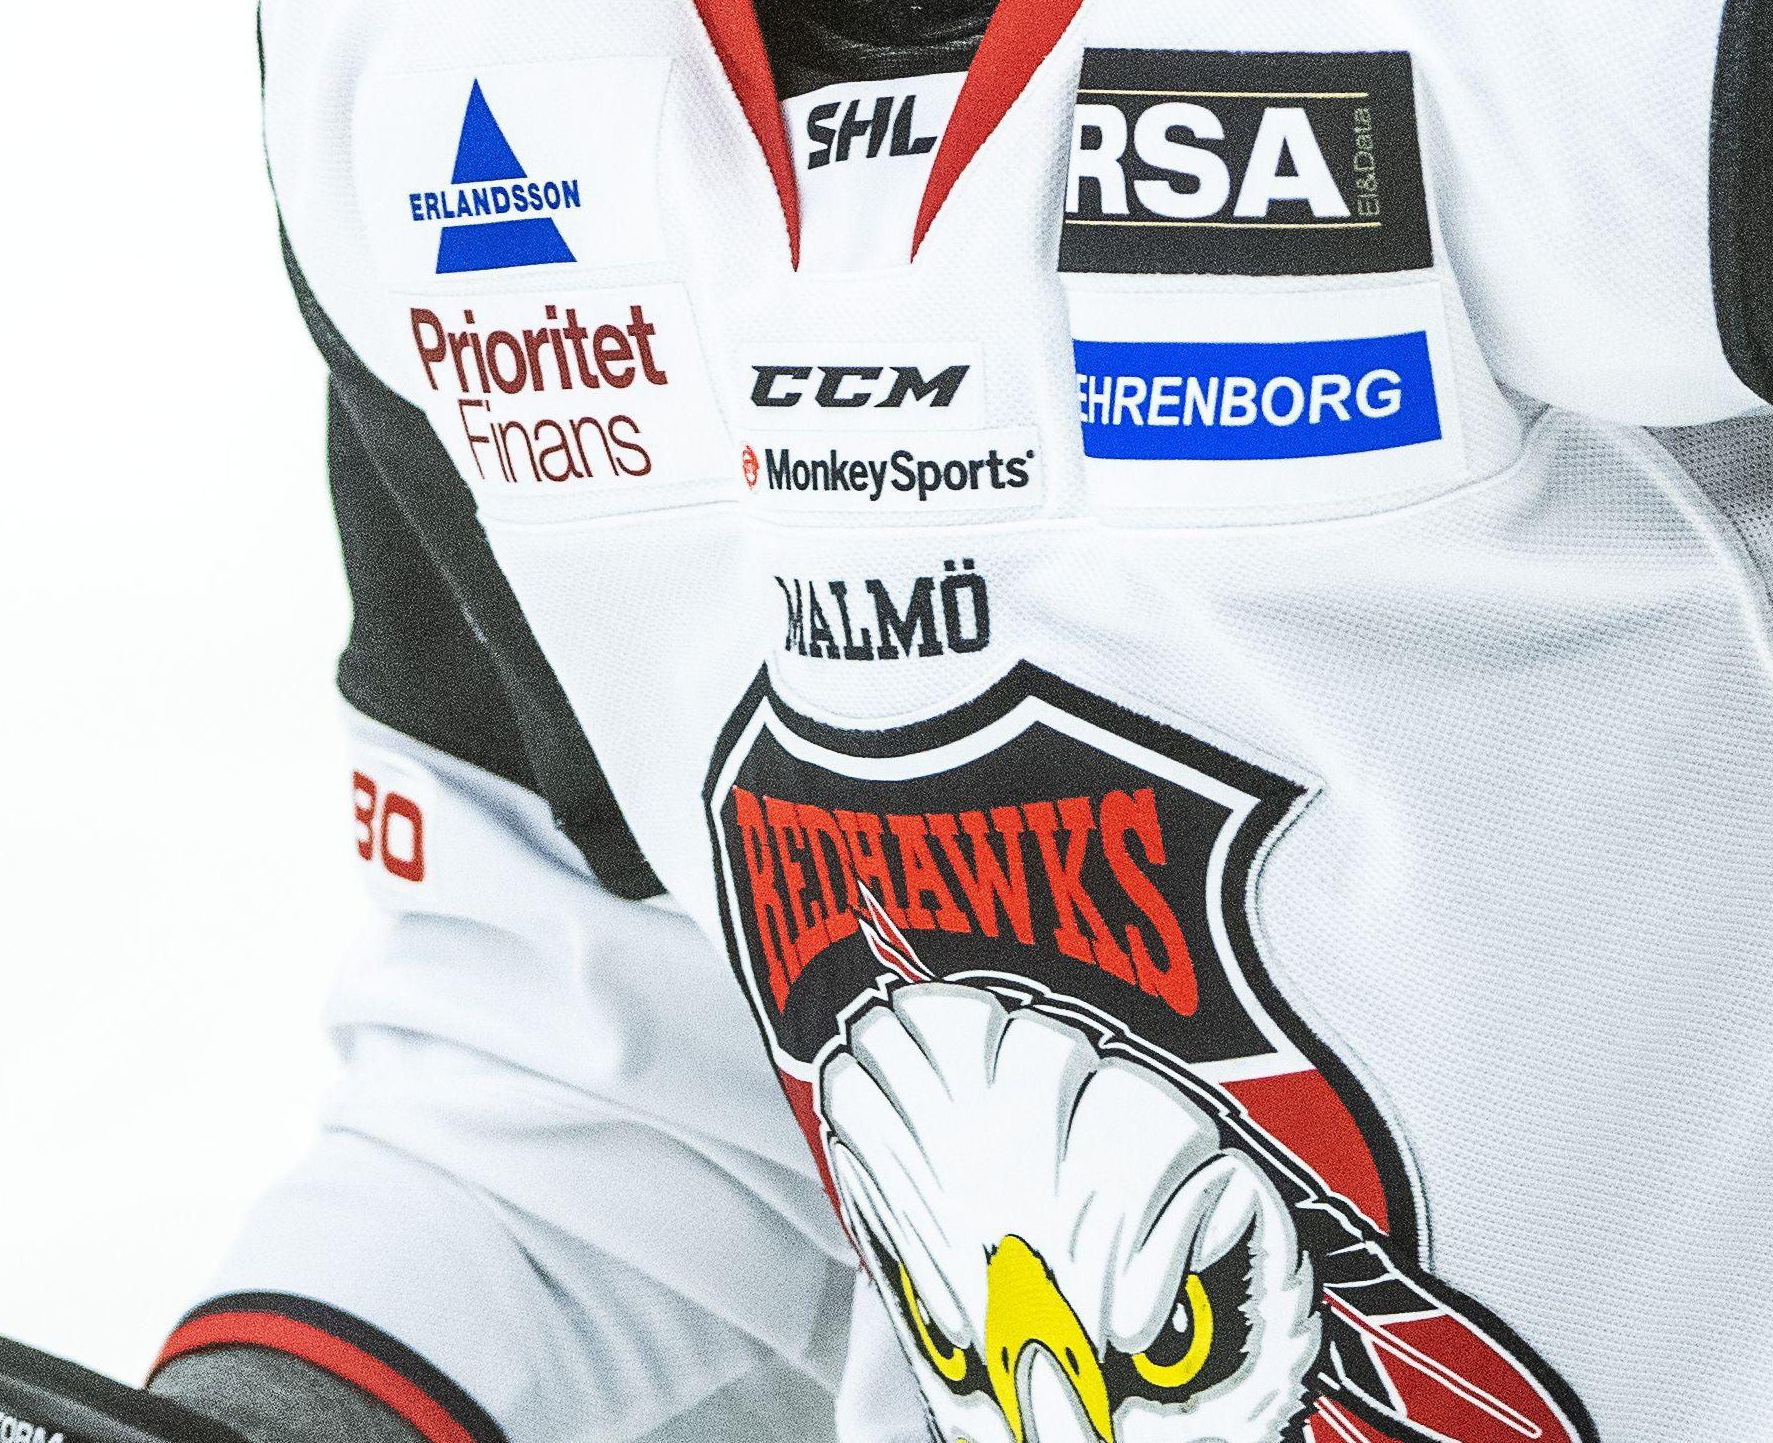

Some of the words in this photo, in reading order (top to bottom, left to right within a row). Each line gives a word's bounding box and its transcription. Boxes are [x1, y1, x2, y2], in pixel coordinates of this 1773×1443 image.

[807, 95, 938, 170] SHL
[1065, 102, 1351, 219] RSA
[409, 179, 581, 222] ERLANDSSON
[409, 304, 668, 394] Prioritet
[750, 365, 970, 408] CCM
[458, 398, 653, 484] Finans
[765, 448, 1030, 502] MonkeySports
[732, 785, 1199, 1017] REDHAWKS
